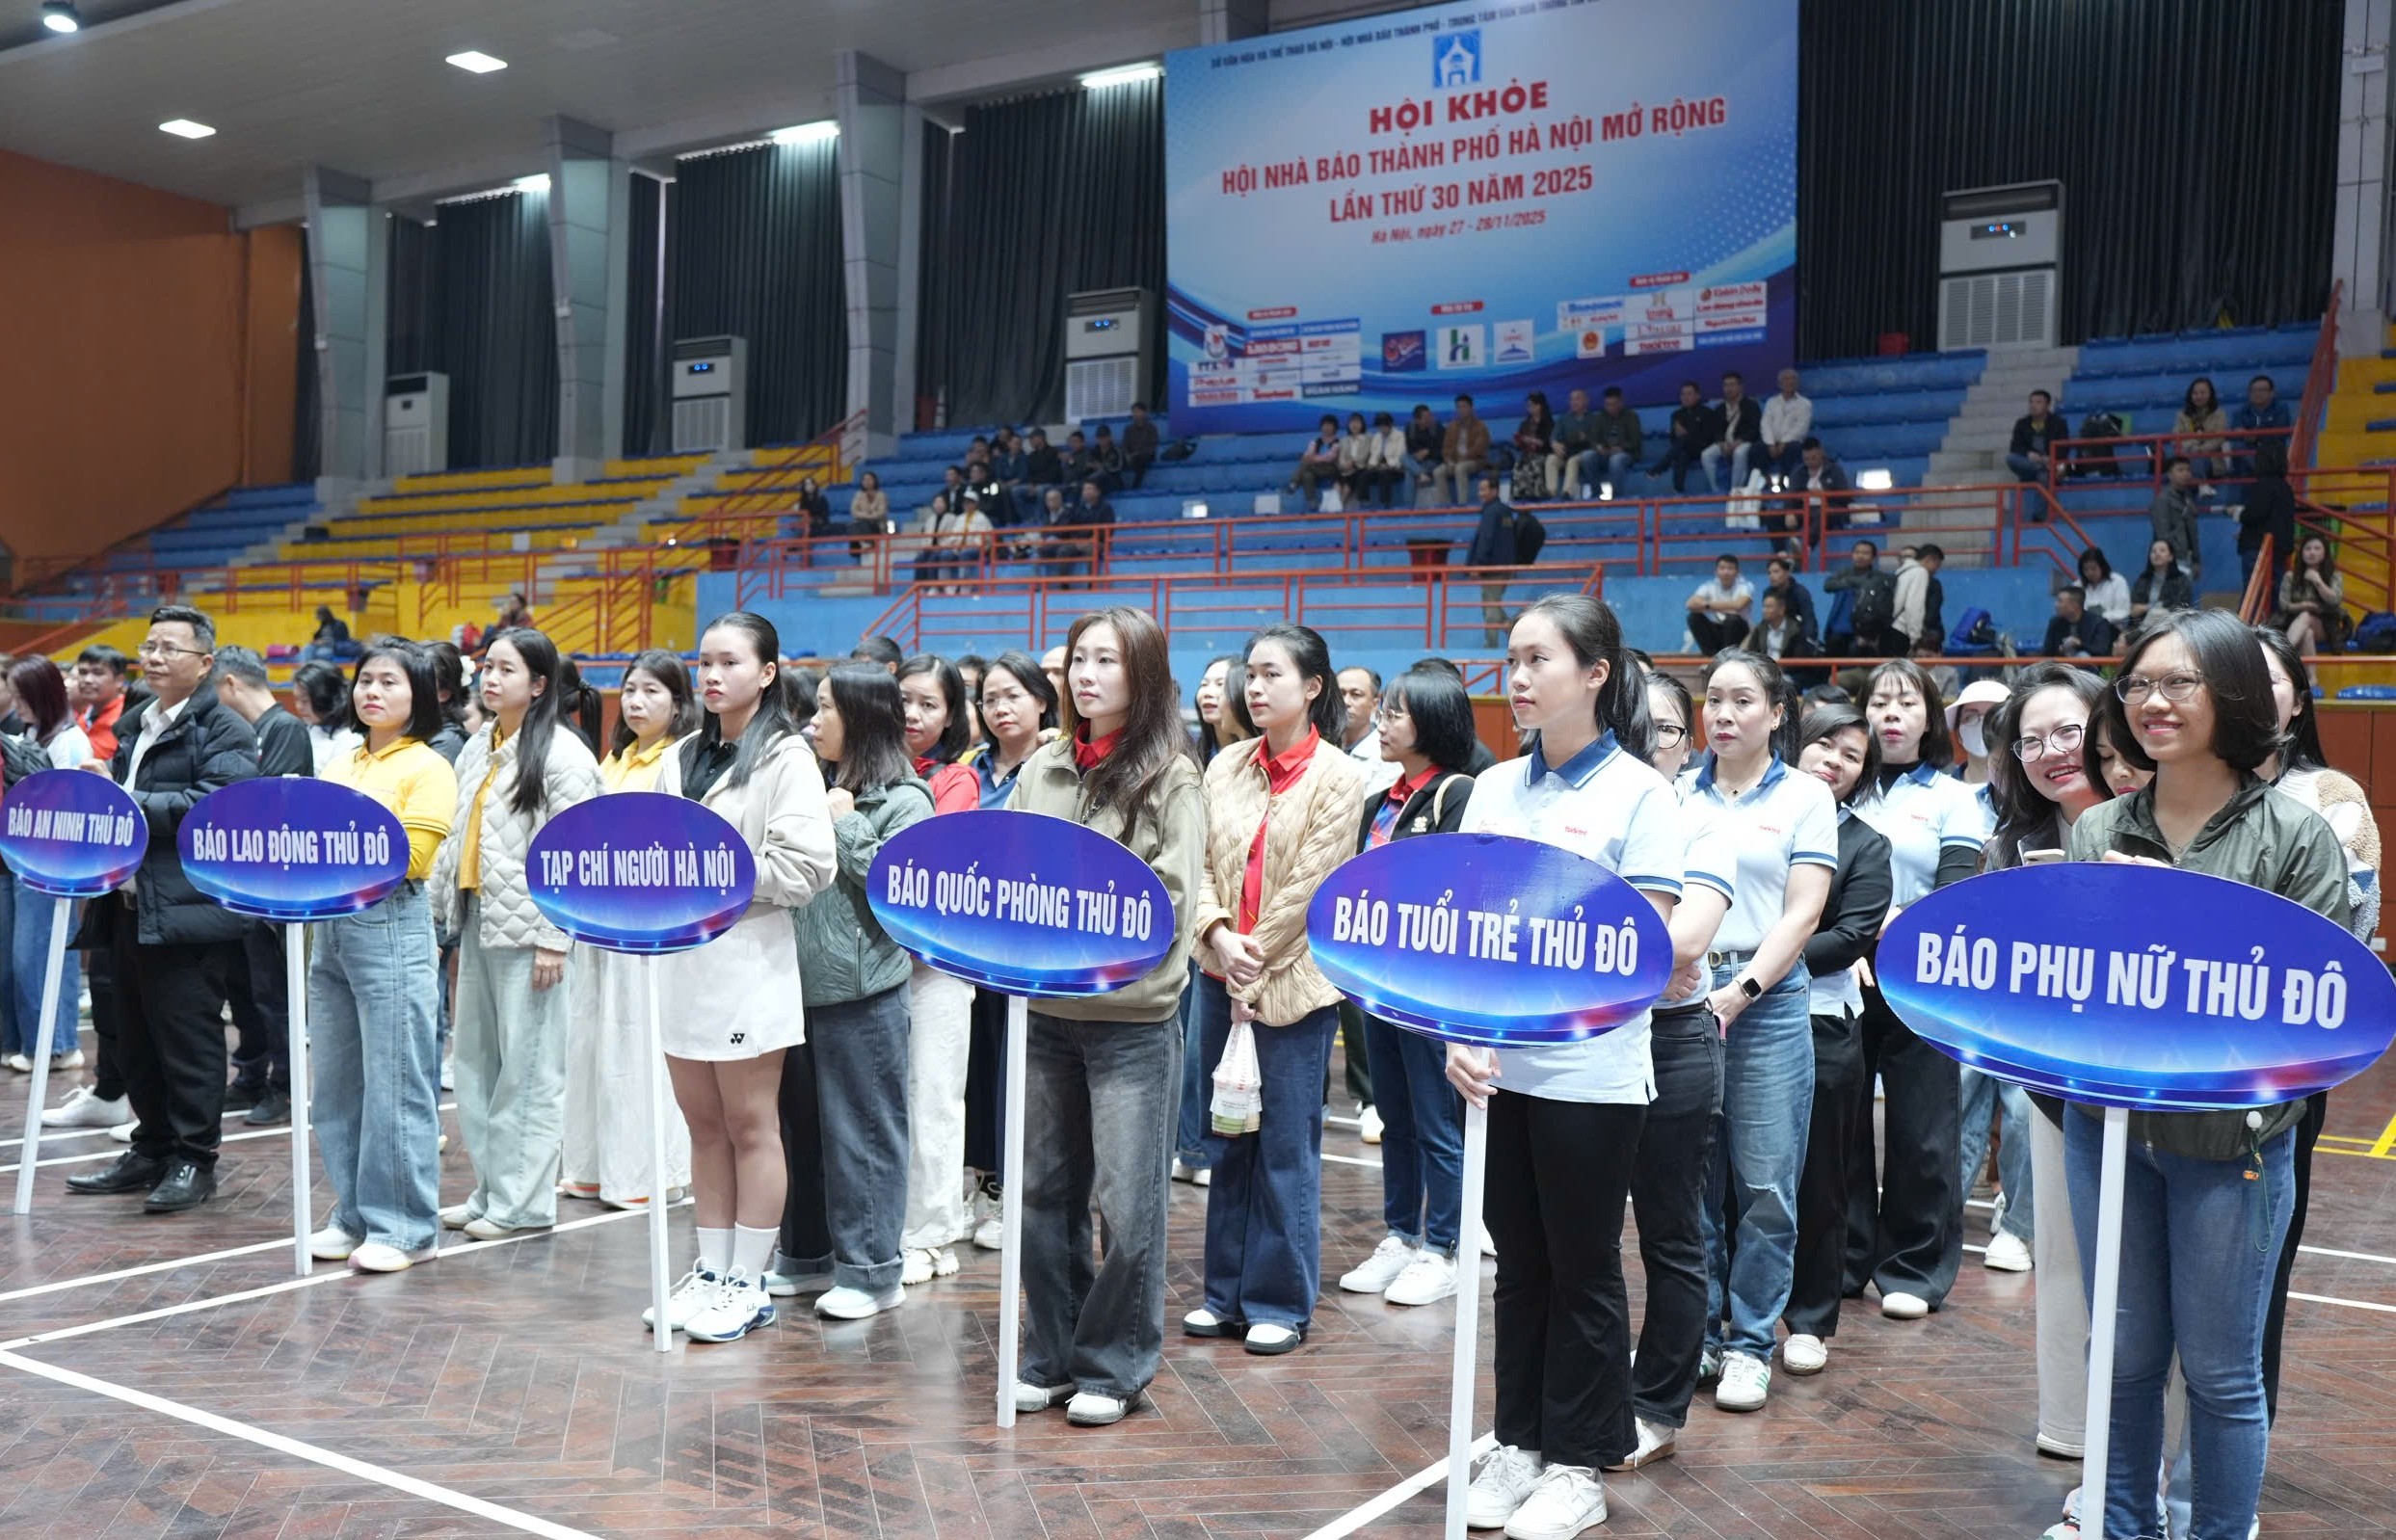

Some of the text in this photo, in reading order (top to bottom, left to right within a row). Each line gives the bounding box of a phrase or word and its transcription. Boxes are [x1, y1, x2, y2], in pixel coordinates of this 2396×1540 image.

[1370, 78, 1548, 136] HỘI KHỎE
[1222, 97, 1725, 198] HỘI NHÀ BÁO THÀNH PHỐ HÀ NỘI MỞ RỘNG
[1381, 183, 1425, 216] THỨ
[1432, 184, 1459, 210] 30
[1468, 173, 1524, 205] NĂM
[1533, 165, 1592, 197] 2025
[1449, 220, 1464, 235] 27
[8, 802, 135, 848] BÁO AN NINH THỦ ĐÔ
[193, 820, 389, 870] BÁO LAO ĐỘNG THỦ ĐÔ
[541, 843, 735, 895] TẠP CHÍ NGƯỜI HÀ NỘI
[887, 861, 1152, 942] BÁO QUỐC PHÒNG THỦ ĐÔ
[1333, 889, 1638, 976] BÁO TUỔI TRẺ THỦ ĐÔ
[1916, 924, 2348, 1029] BÁO PHỤ NỮ THỦ ĐÔ
